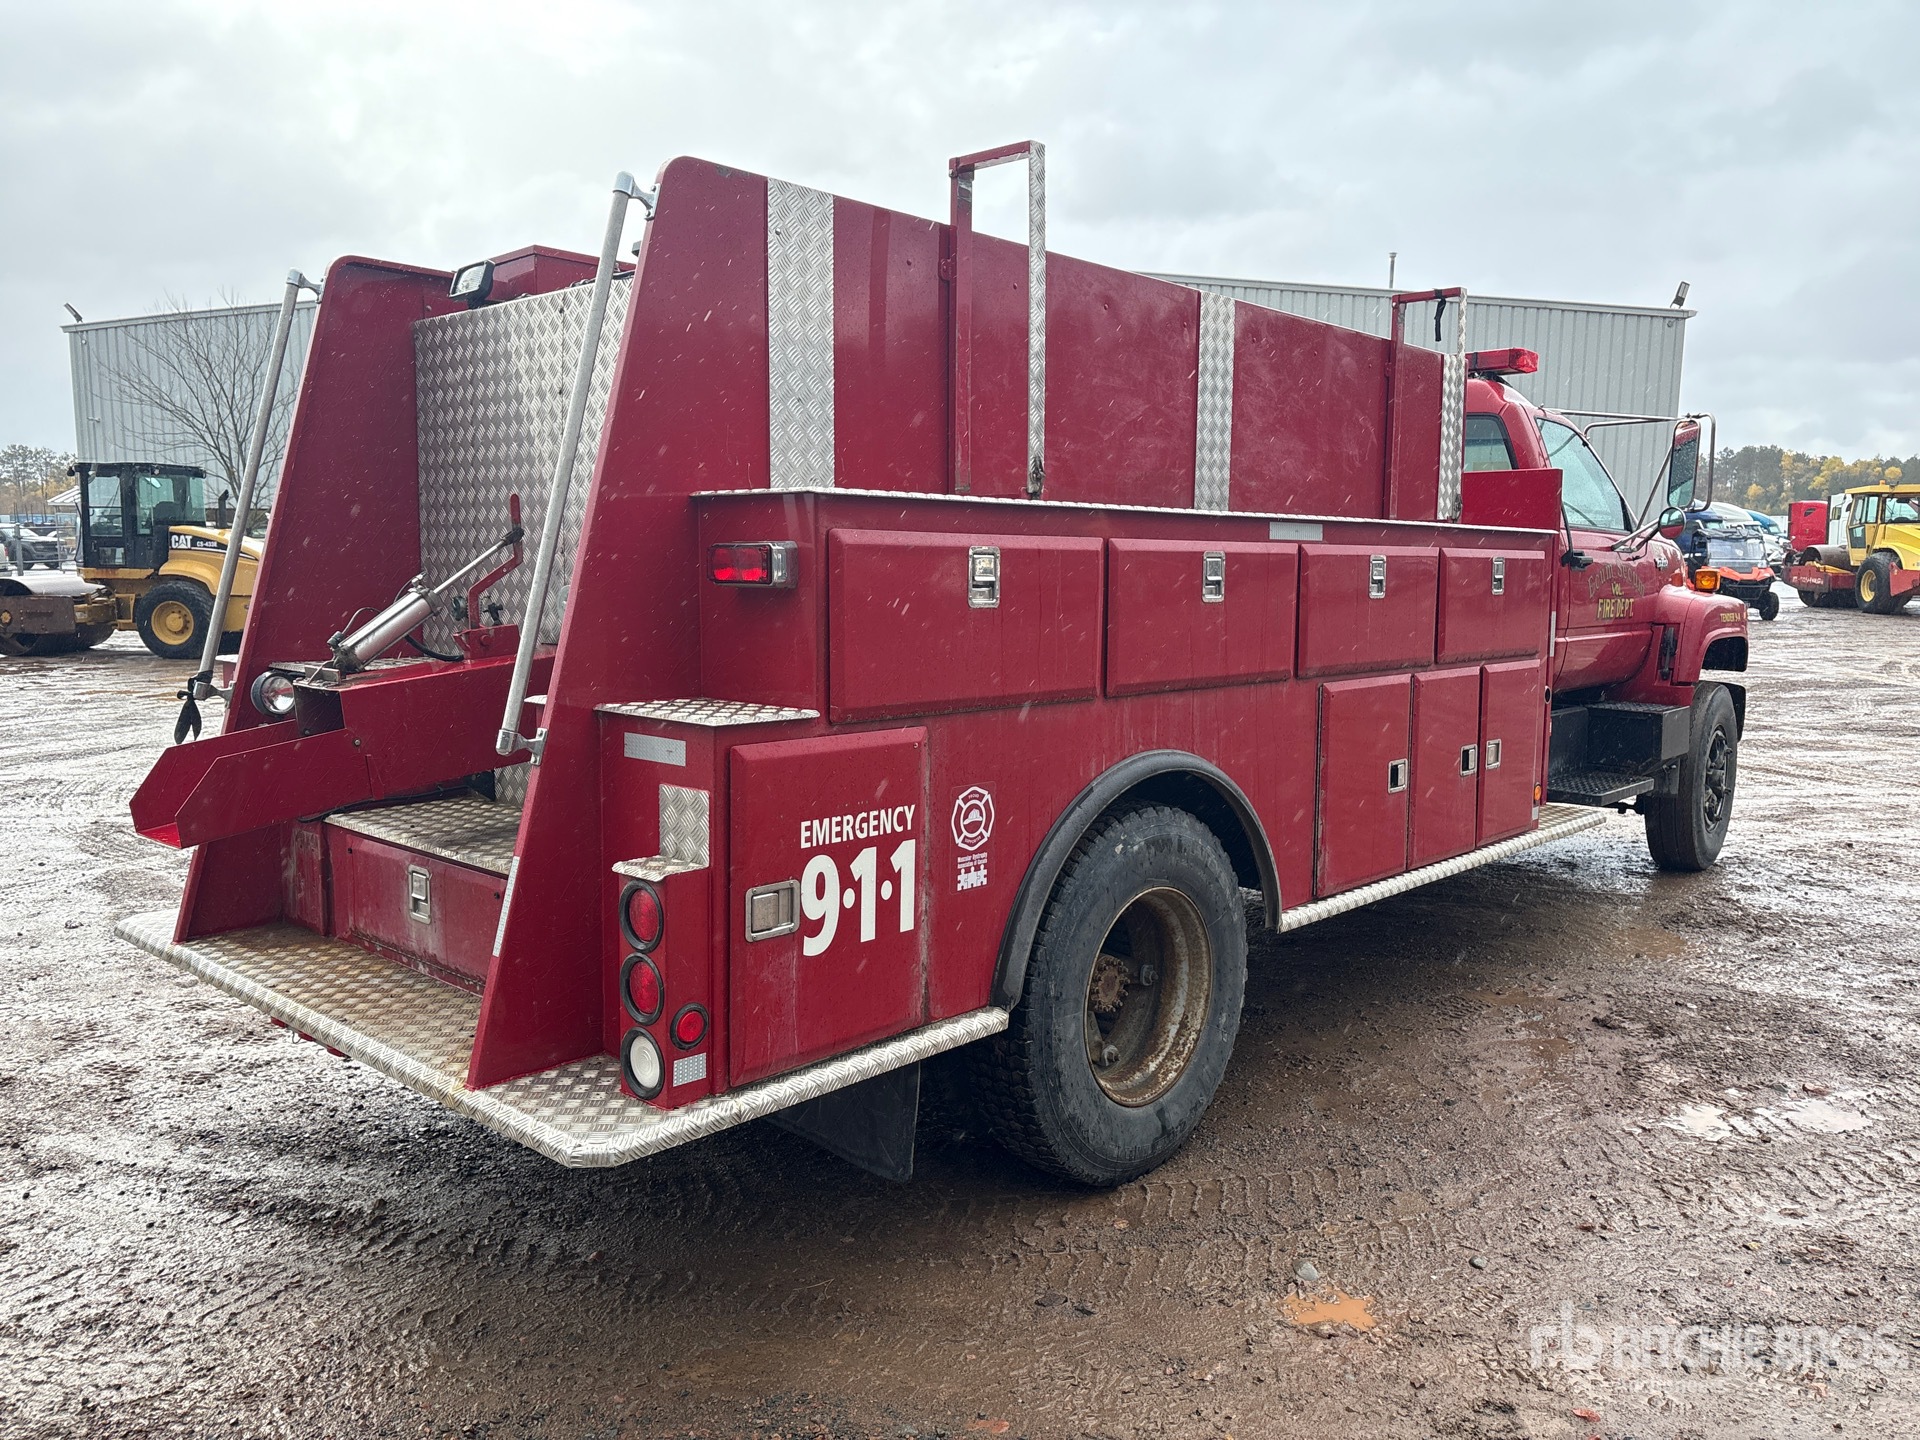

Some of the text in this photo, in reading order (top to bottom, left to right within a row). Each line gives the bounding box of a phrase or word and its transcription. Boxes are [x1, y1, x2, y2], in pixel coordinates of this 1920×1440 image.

[171, 534, 193, 549] CAT
[1597, 598, 1615, 619] FIRE
[801, 804, 915, 849] EMERGENCY
